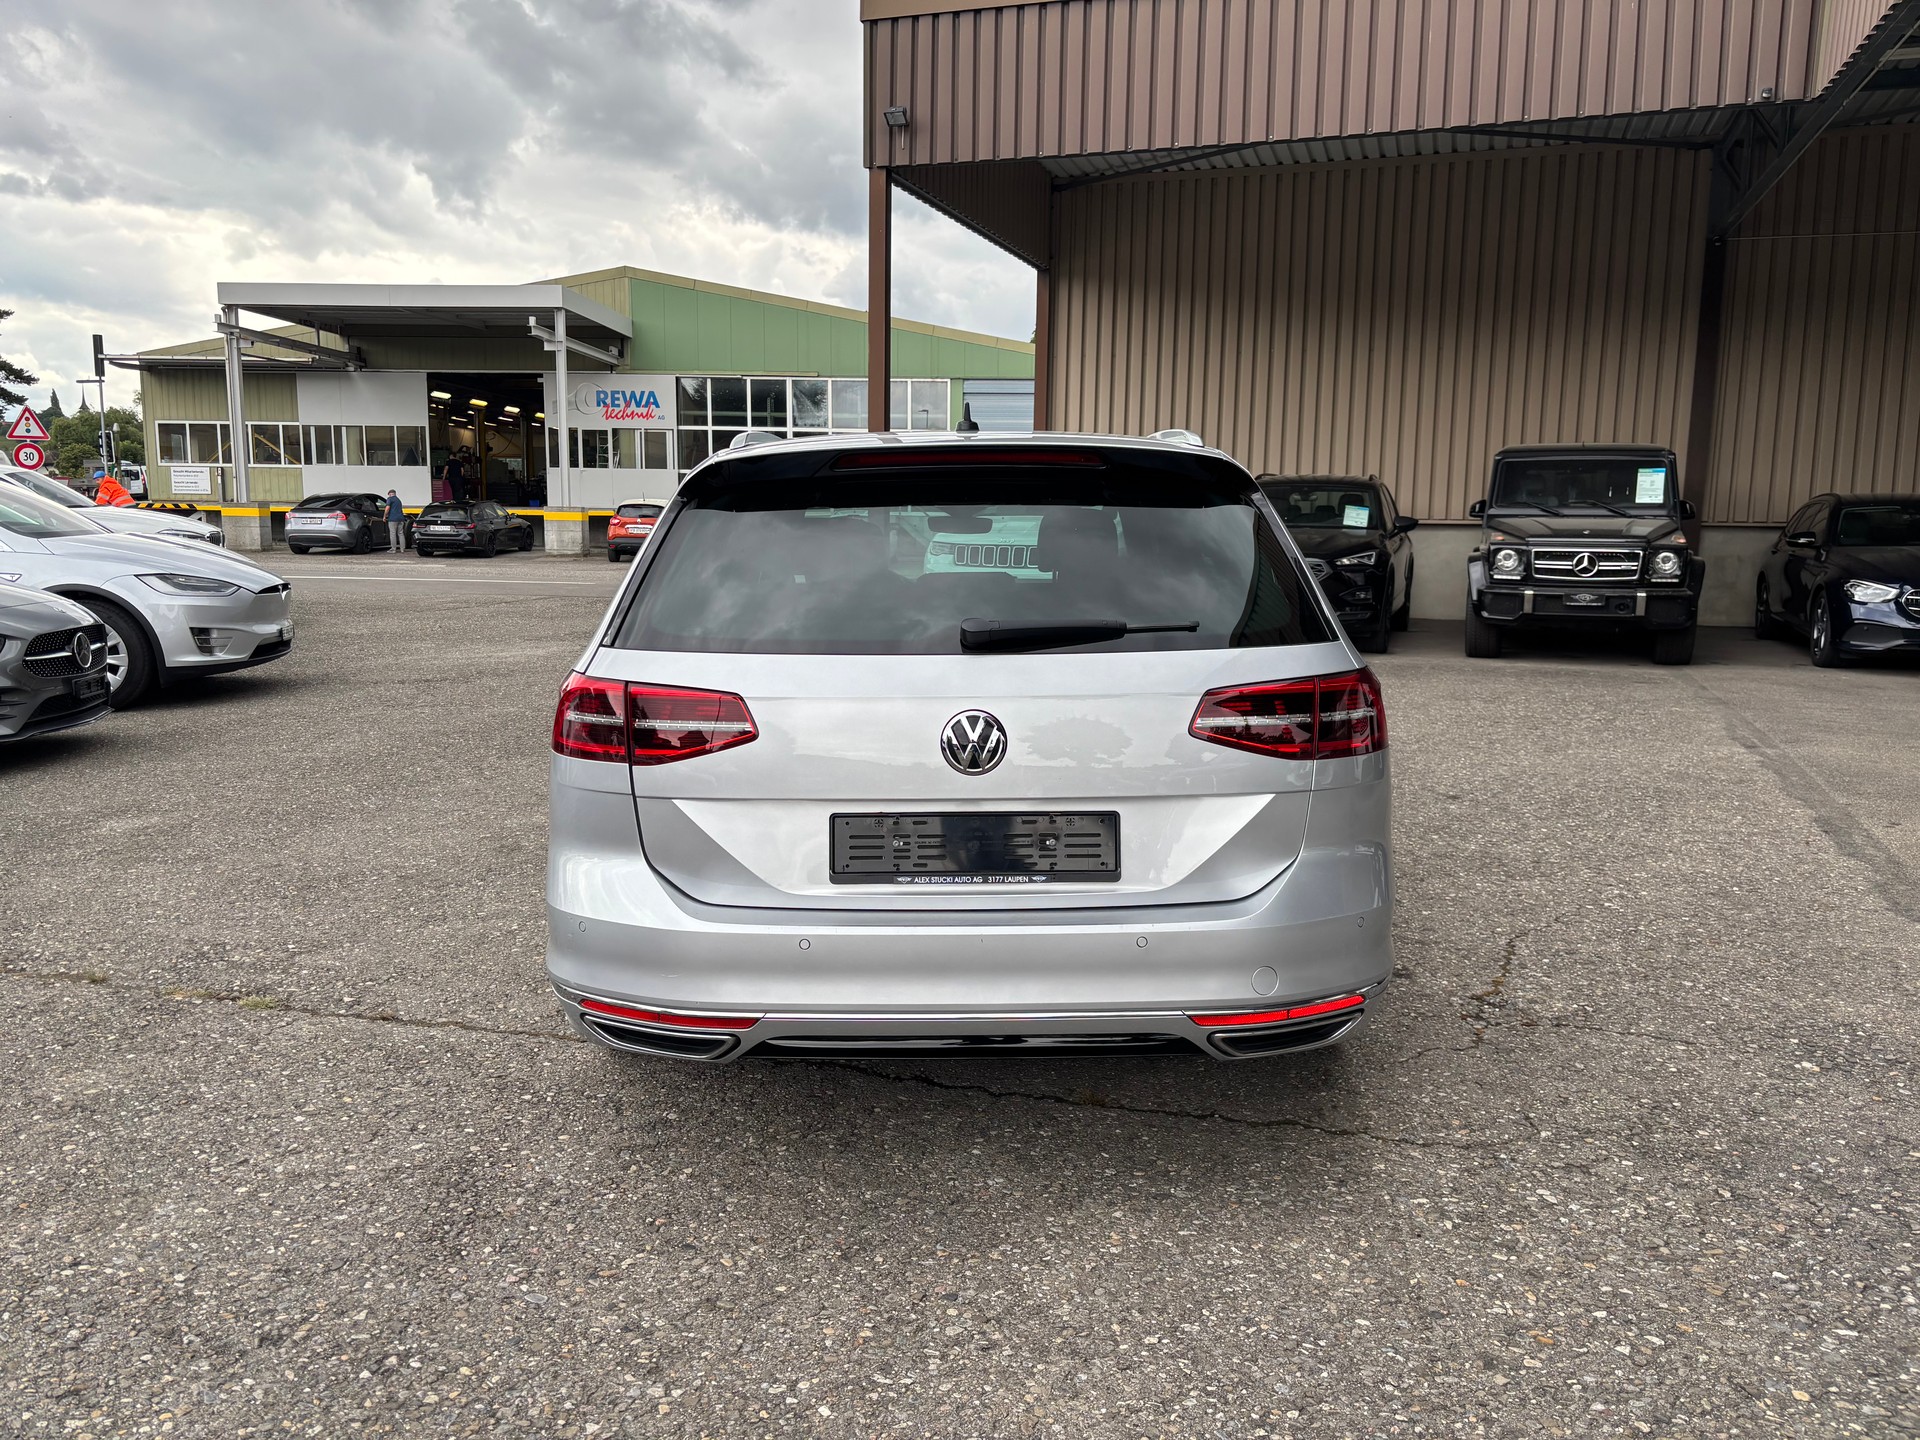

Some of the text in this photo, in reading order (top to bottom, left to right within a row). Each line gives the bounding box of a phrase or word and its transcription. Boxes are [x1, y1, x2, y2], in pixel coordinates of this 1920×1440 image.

[596, 390, 661, 408] REWA
[602, 400, 656, 420] technik
[23, 451, 35, 461] 30
